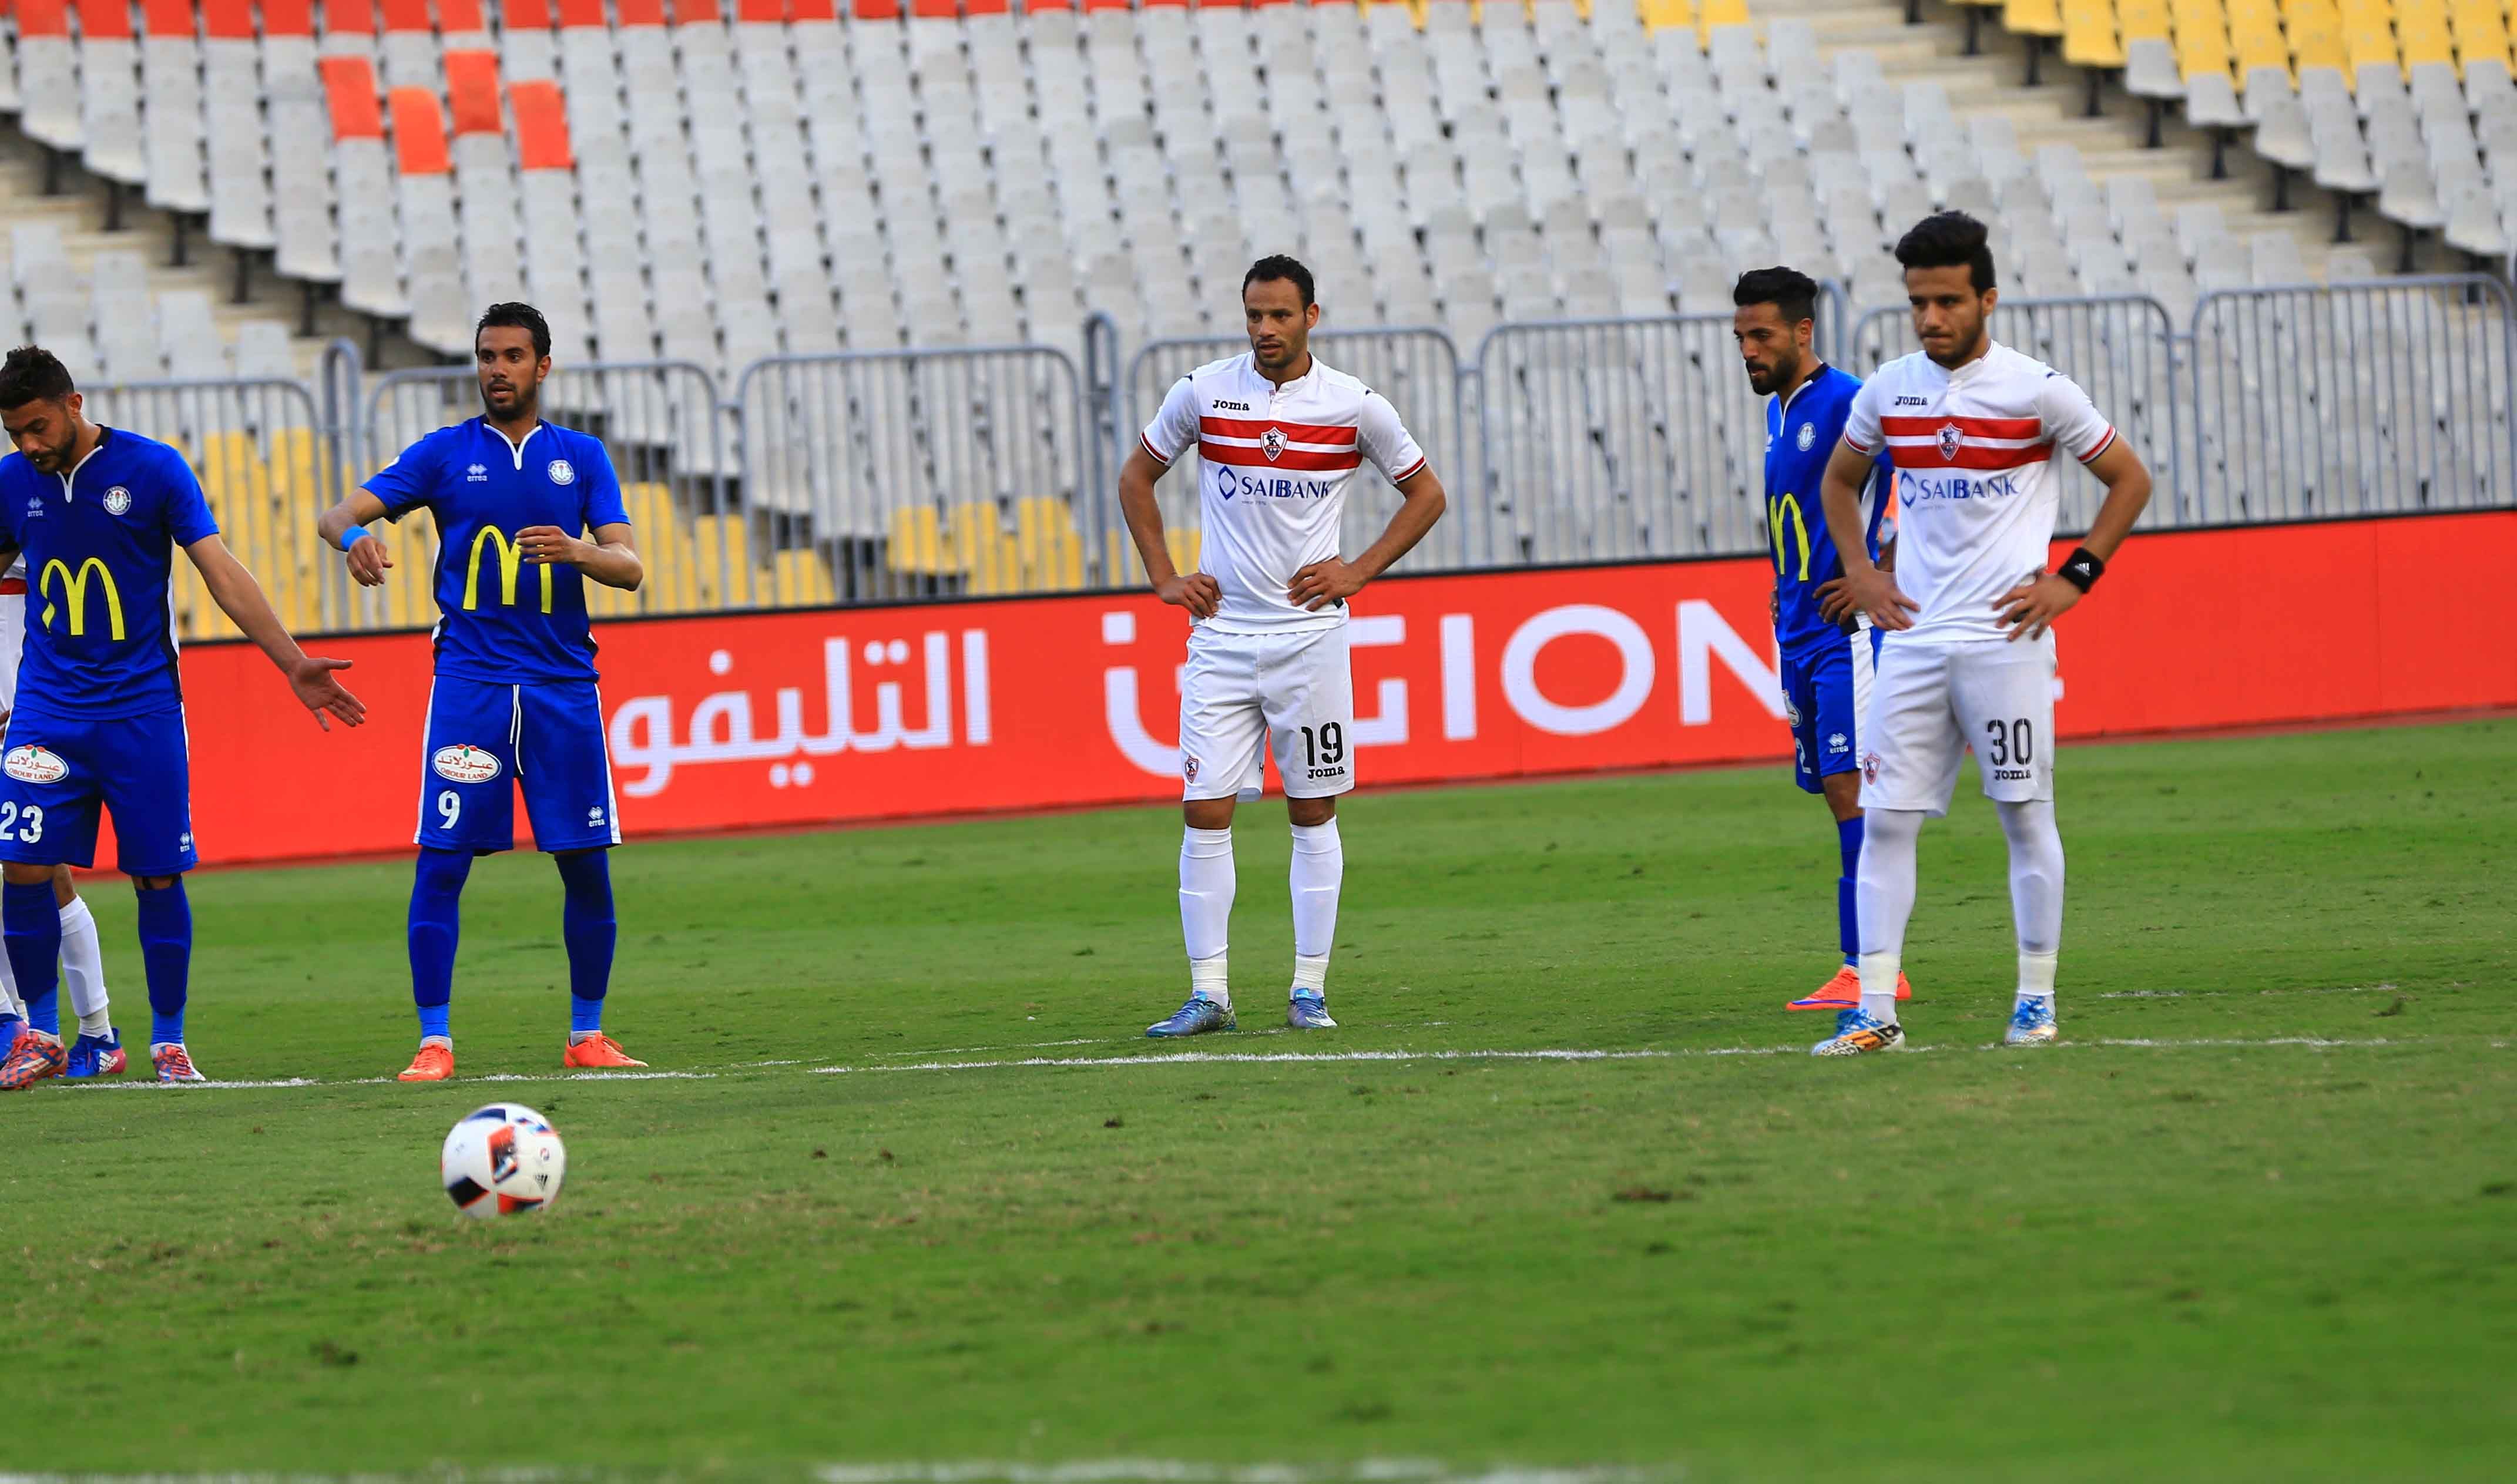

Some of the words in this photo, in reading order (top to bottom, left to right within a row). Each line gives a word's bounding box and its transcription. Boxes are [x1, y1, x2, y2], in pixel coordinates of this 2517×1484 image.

[609, 628, 993, 798] التليفو
[1301, 721, 1344, 767] 19
[1988, 718, 2033, 766] 30
[0, 801, 43, 844] 23
[438, 790, 461, 829] 9
